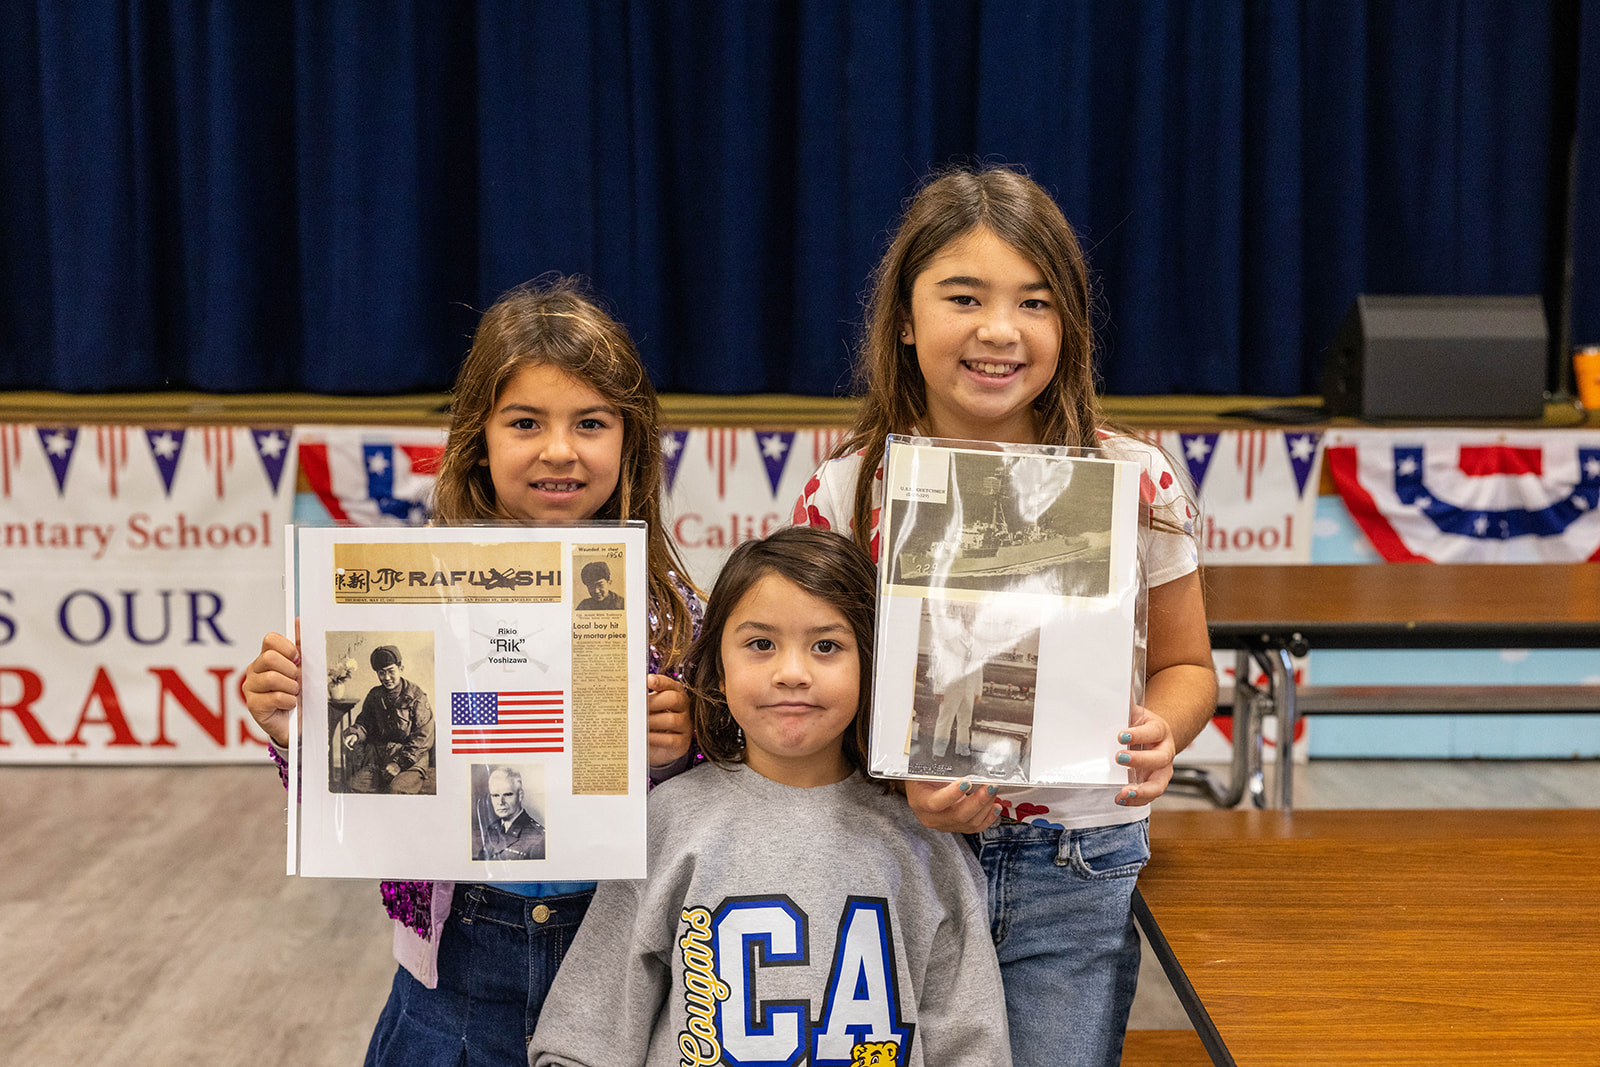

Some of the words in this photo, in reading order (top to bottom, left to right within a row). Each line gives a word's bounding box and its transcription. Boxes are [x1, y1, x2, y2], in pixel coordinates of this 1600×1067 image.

[0, 517, 115, 561] ntary
[126, 511, 272, 550] School
[673, 511, 779, 549] Calif
[1196, 513, 1294, 551] hool
[57, 587, 235, 646] OUR
[497, 627, 518, 635] Rikio
[573, 621, 592, 630] Local
[594, 621, 608, 631] boy
[609, 621, 619, 629] hit
[573, 631, 583, 640] by
[607, 631, 627, 640] piece
[488, 656, 528, 664] Yoshizawa
[490, 638, 526, 653] “Rik”
[677, 904, 731, 1067] Cougars
[712, 893, 916, 1067] CA
